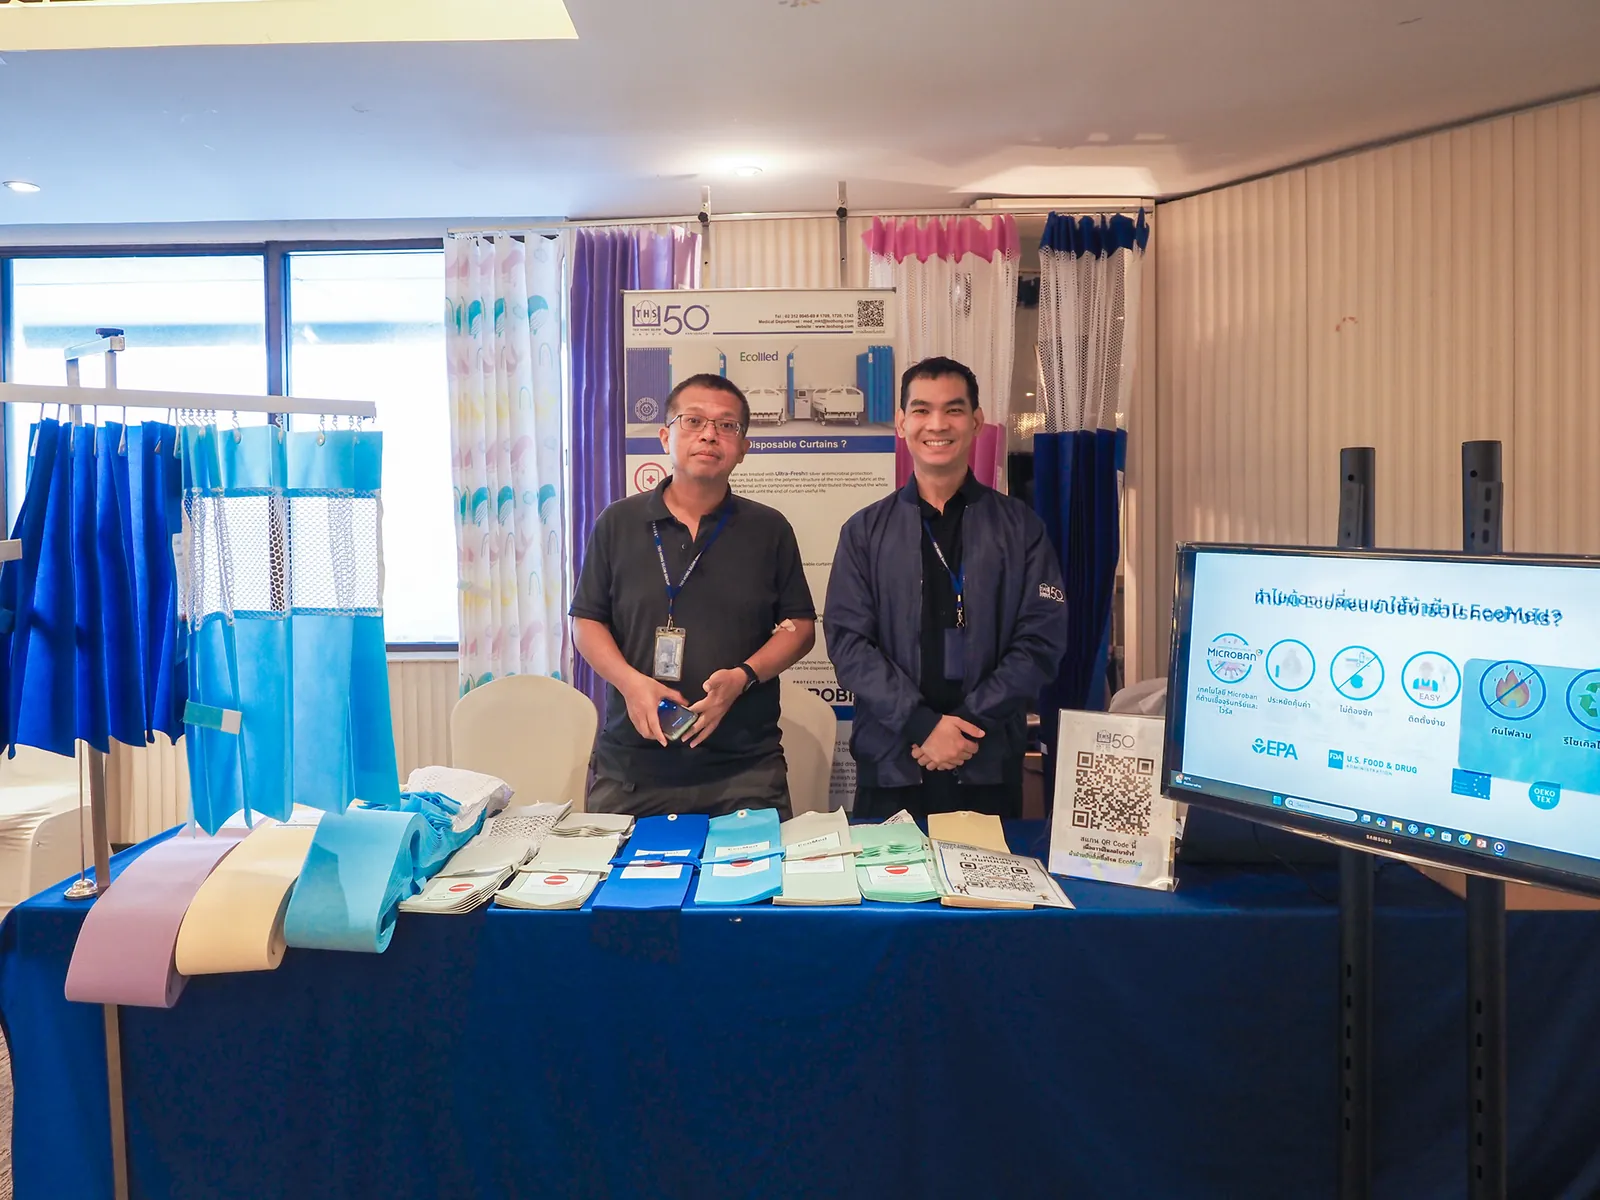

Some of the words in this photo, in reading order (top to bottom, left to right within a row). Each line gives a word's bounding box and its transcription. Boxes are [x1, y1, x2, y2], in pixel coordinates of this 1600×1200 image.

[636, 309, 657, 318] THS
[663, 304, 710, 336] 50
[799, 439, 839, 449] Curtains
[841, 439, 848, 449] ?
[1050, 586, 1064, 600] 50
[1207, 647, 1257, 661] MICROBAN
[1227, 690, 1258, 700] Microban
[1419, 692, 1441, 702] EASY
[1339, 704, 1373, 717] ไม่ต้องซัก
[1408, 714, 1446, 727] ติดตั้งง่าย
[1491, 726, 1532, 739] กันไฟลาม
[1111, 733, 1136, 749] 50
[1266, 739, 1299, 761] EPA
[1329, 752, 1343, 761] FDA
[1346, 755, 1361, 765] U.S.
[1363, 757, 1384, 769] FOOD
[1394, 763, 1418, 774] DRUG
[1533, 788, 1556, 798] OEKO
[1536, 795, 1551, 804] TEX
[1101, 838, 1111, 846] QR
[1112, 840, 1129, 849] Code
[1366, 834, 1392, 845] SAMSUNG
